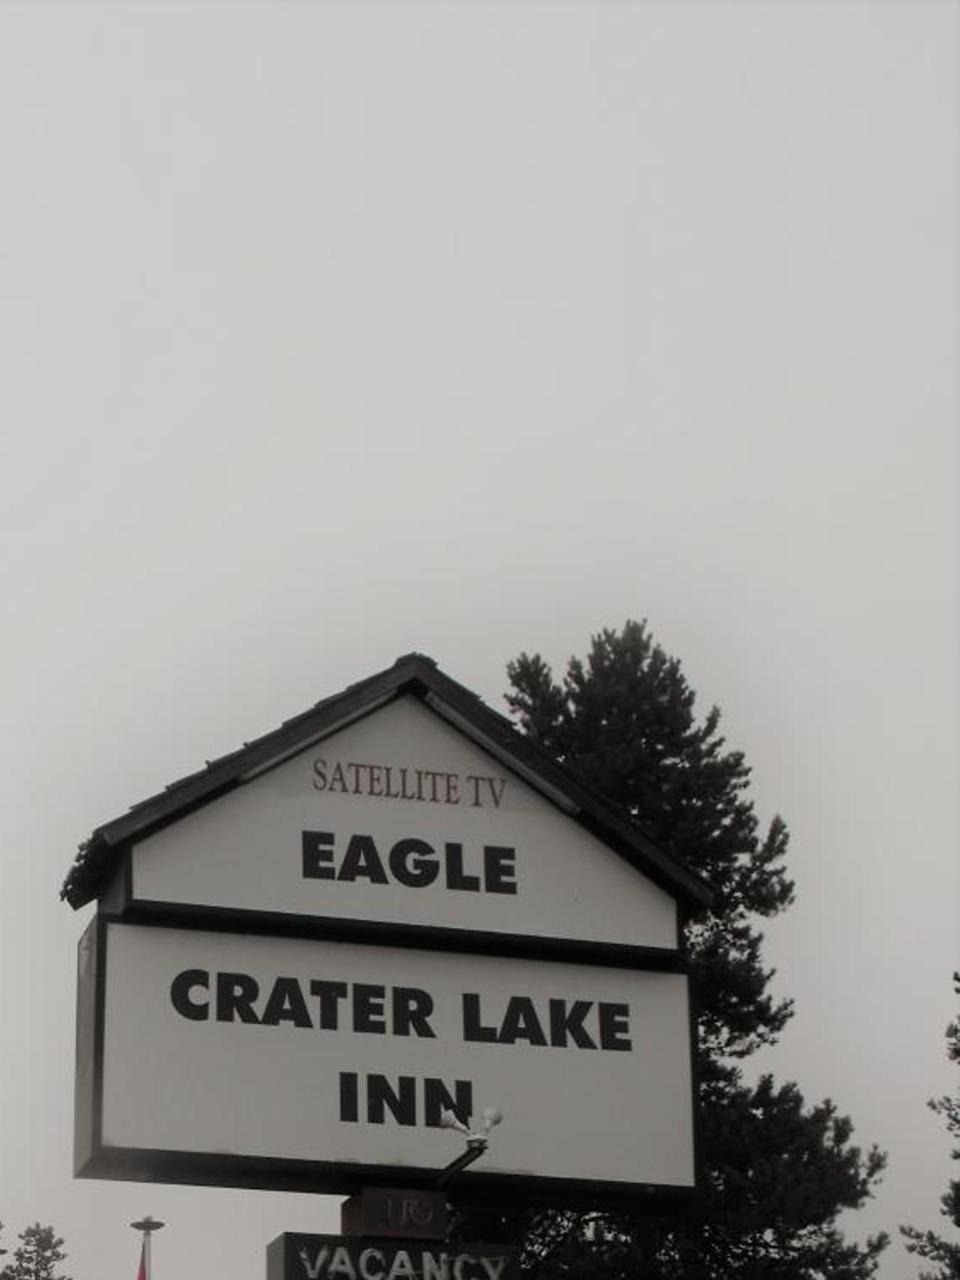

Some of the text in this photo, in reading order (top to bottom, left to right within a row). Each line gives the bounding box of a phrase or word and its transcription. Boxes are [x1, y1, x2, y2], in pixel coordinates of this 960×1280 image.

[313, 759, 508, 808] SATELLITE TV
[302, 830, 517, 895] EAGLE
[170, 969, 632, 1051] CRATER LAKE
[339, 1072, 472, 1130] INN
